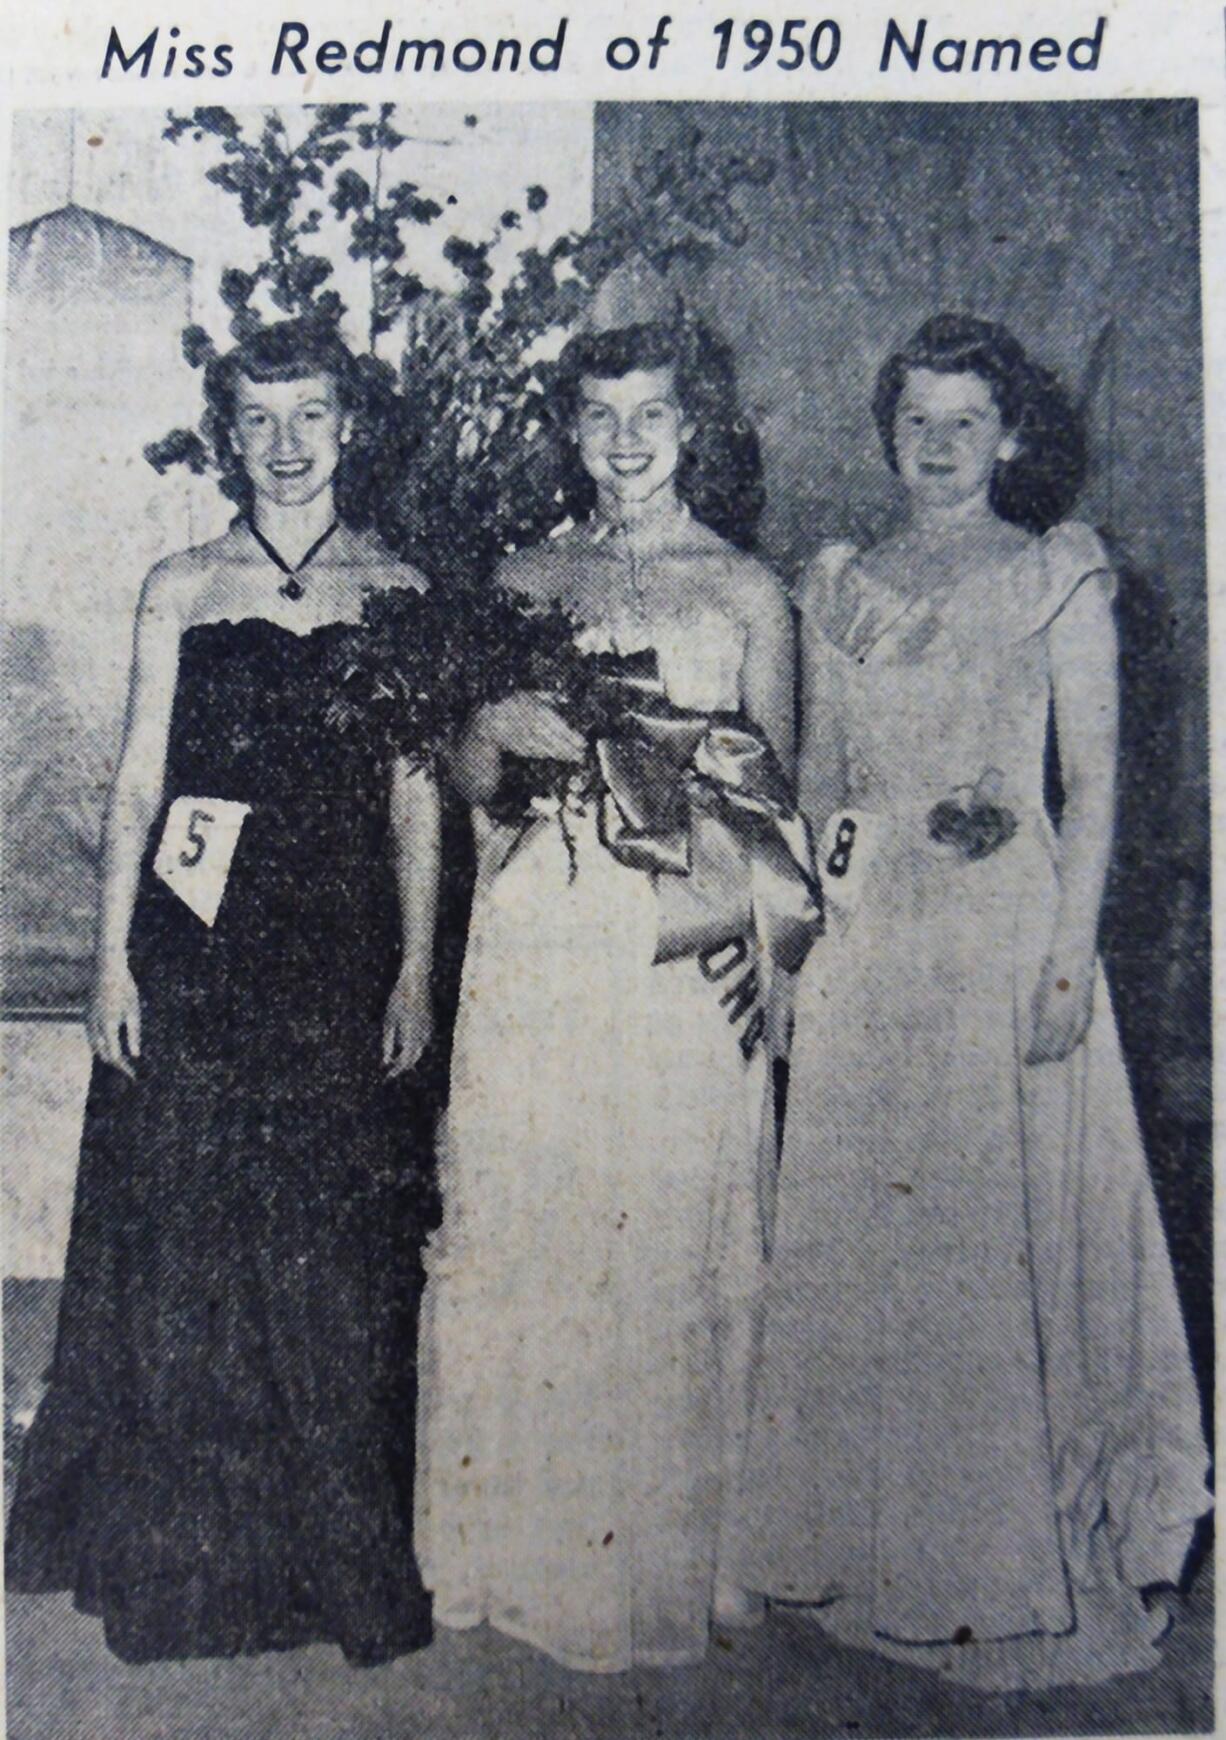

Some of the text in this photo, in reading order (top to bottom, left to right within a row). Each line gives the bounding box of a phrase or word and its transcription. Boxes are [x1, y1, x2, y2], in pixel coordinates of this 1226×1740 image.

[101, 15, 1106, 78] Miss Redmond of 1950 Named
[179, 809, 215, 868] 5
[827, 818, 857, 877] 8
